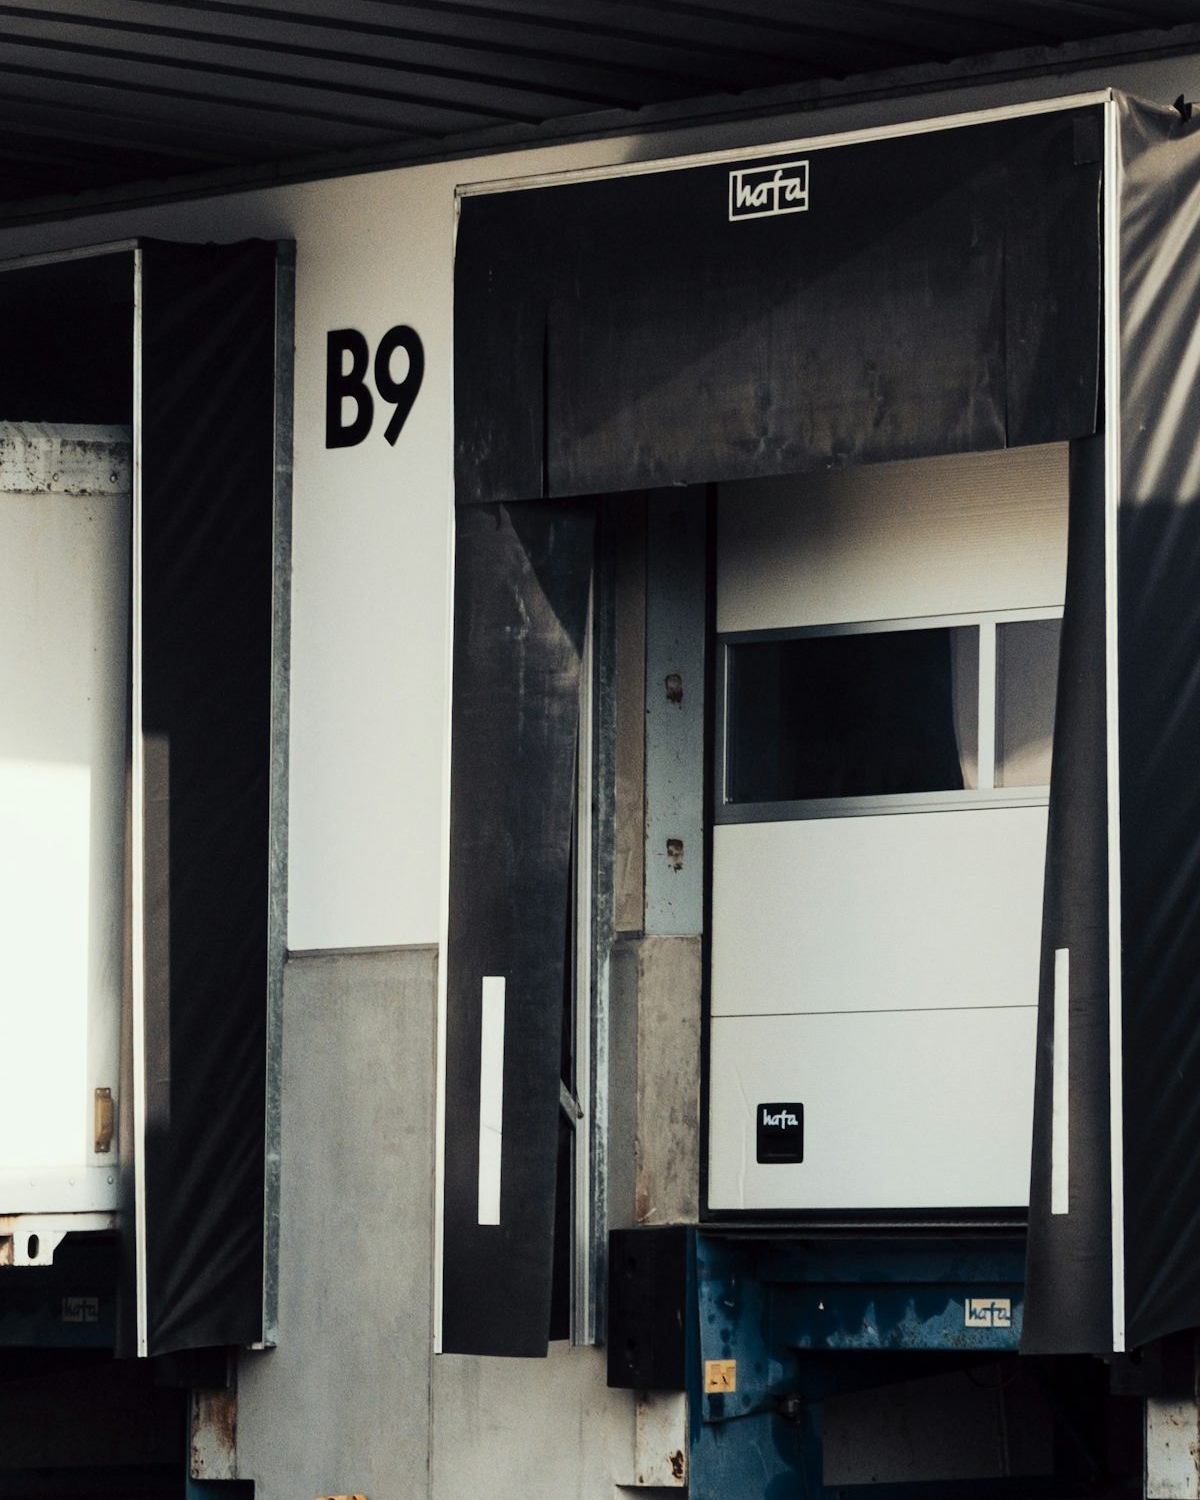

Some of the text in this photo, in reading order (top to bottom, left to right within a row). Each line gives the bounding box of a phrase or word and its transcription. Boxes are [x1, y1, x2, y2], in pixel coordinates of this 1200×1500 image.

[736, 168, 806, 211] hafa
[325, 324, 425, 449] B9
[763, 1108, 799, 1130] hafa
[968, 1299, 1011, 1327] hafa
